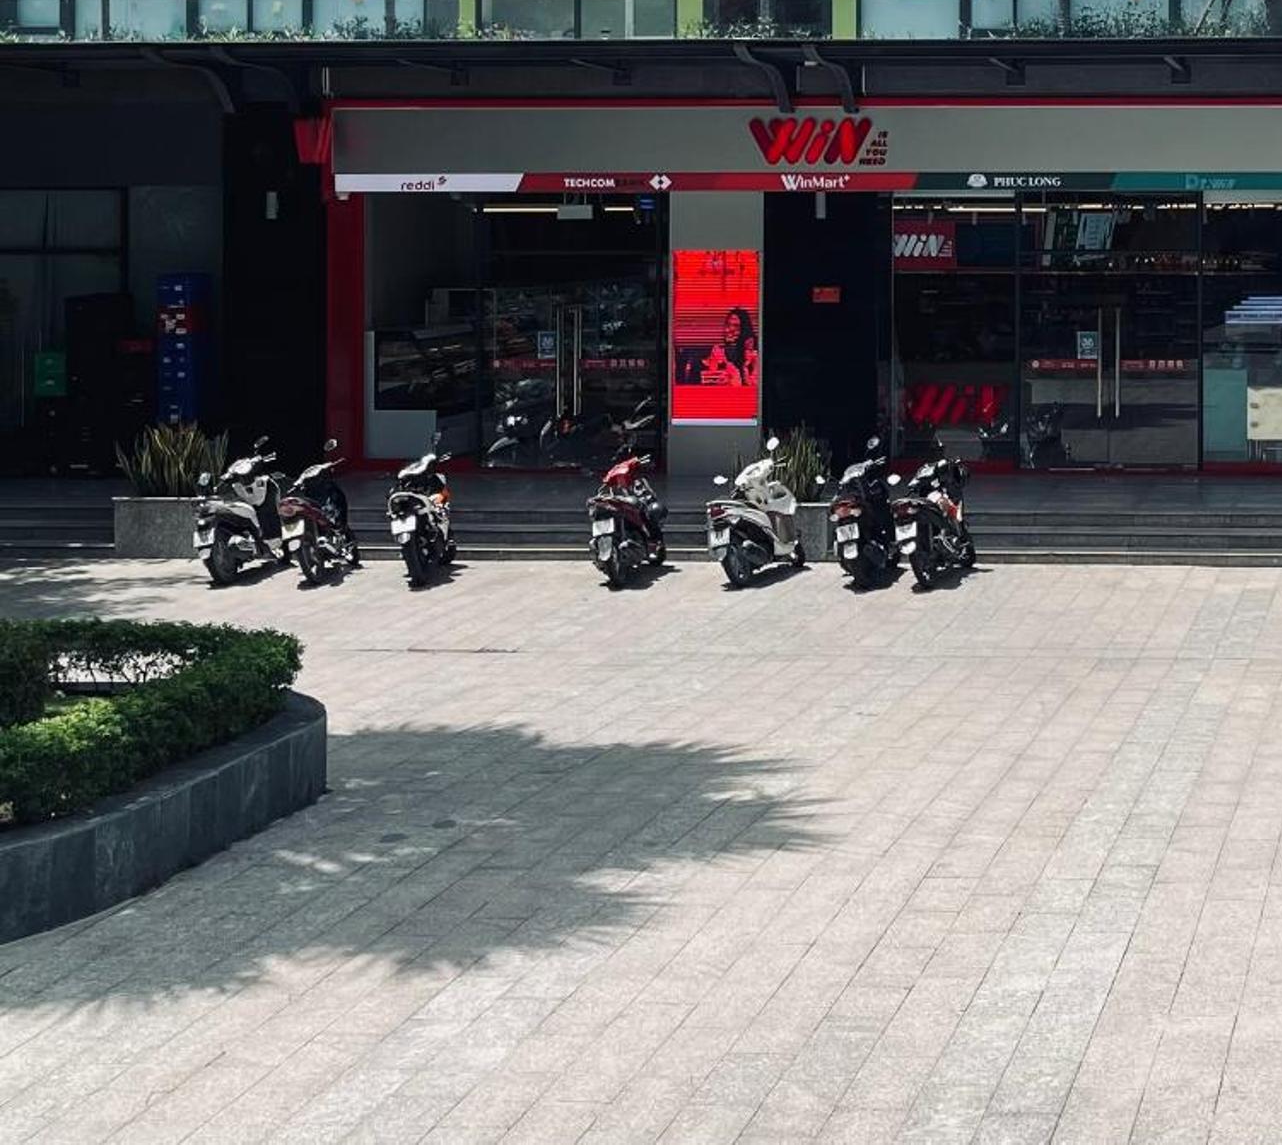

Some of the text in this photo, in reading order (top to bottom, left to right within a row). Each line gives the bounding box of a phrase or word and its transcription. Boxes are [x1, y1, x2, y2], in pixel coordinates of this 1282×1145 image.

[859, 157, 886, 165] NEED
[400, 180, 434, 191] reddi
[1029, 176, 1062, 187] LONG
